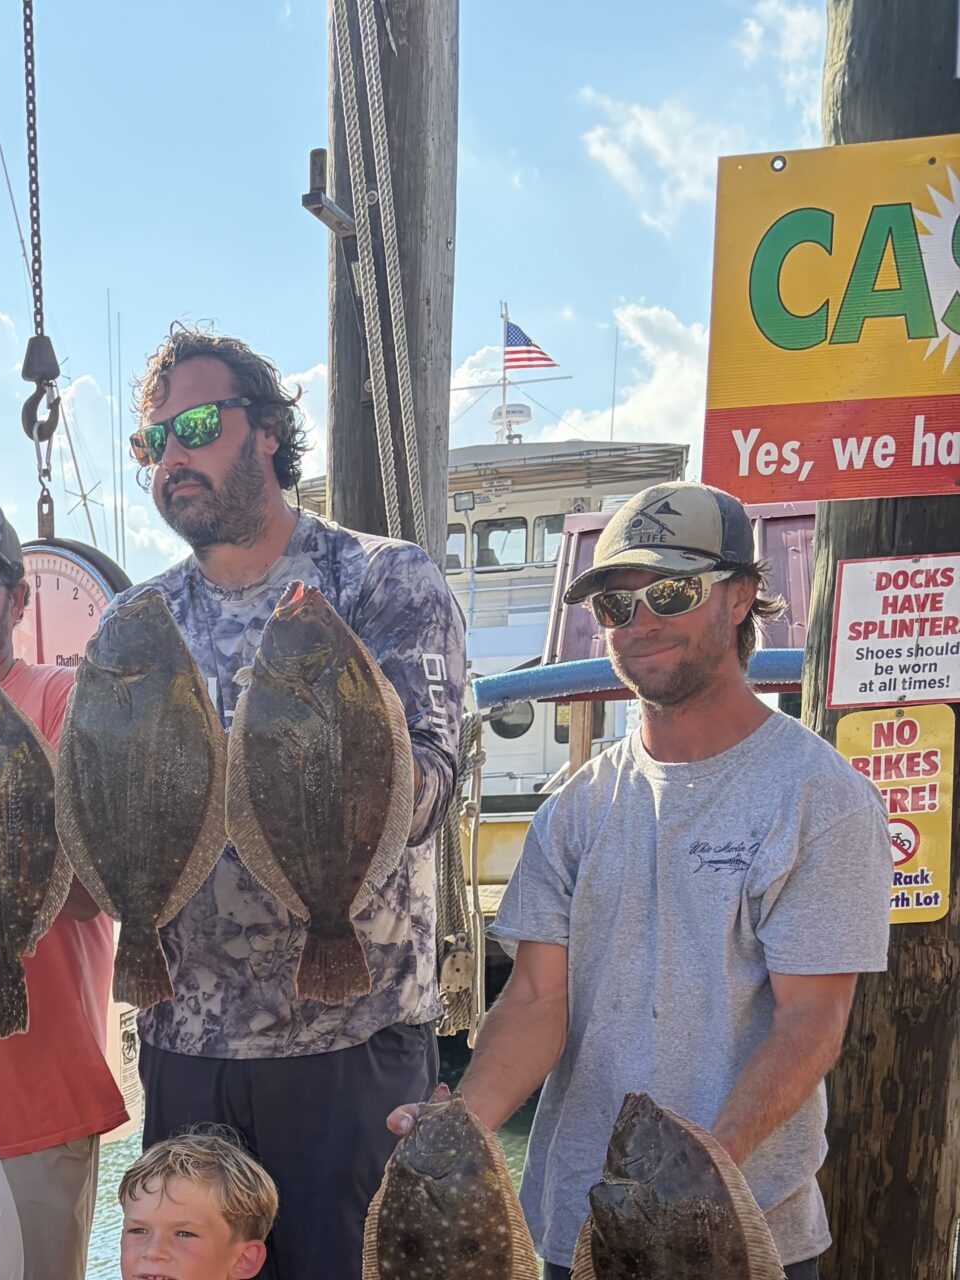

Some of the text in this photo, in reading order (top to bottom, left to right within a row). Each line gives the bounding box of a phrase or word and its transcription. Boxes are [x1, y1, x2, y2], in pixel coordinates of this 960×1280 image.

[732, 428, 814, 481] Yes,
[833, 435, 896, 472] we
[639, 534, 667, 543] LIFE
[875, 567, 955, 591] DOCKS
[73, 587, 79, 600] 2
[88, 604, 94, 616] 3
[882, 592, 944, 615] HAVE
[848, 616, 960, 641] SPLINTER
[856, 642, 960, 660] Shoes should
[874, 662, 938, 676] be worn
[859, 675, 951, 692] at all times!
[873, 719, 918, 748] NO
[852, 749, 939, 781] BIKES
[881, 784, 938, 814] RE!
[893, 868, 930, 886] Rack
[915, 892, 940, 907] Lot
